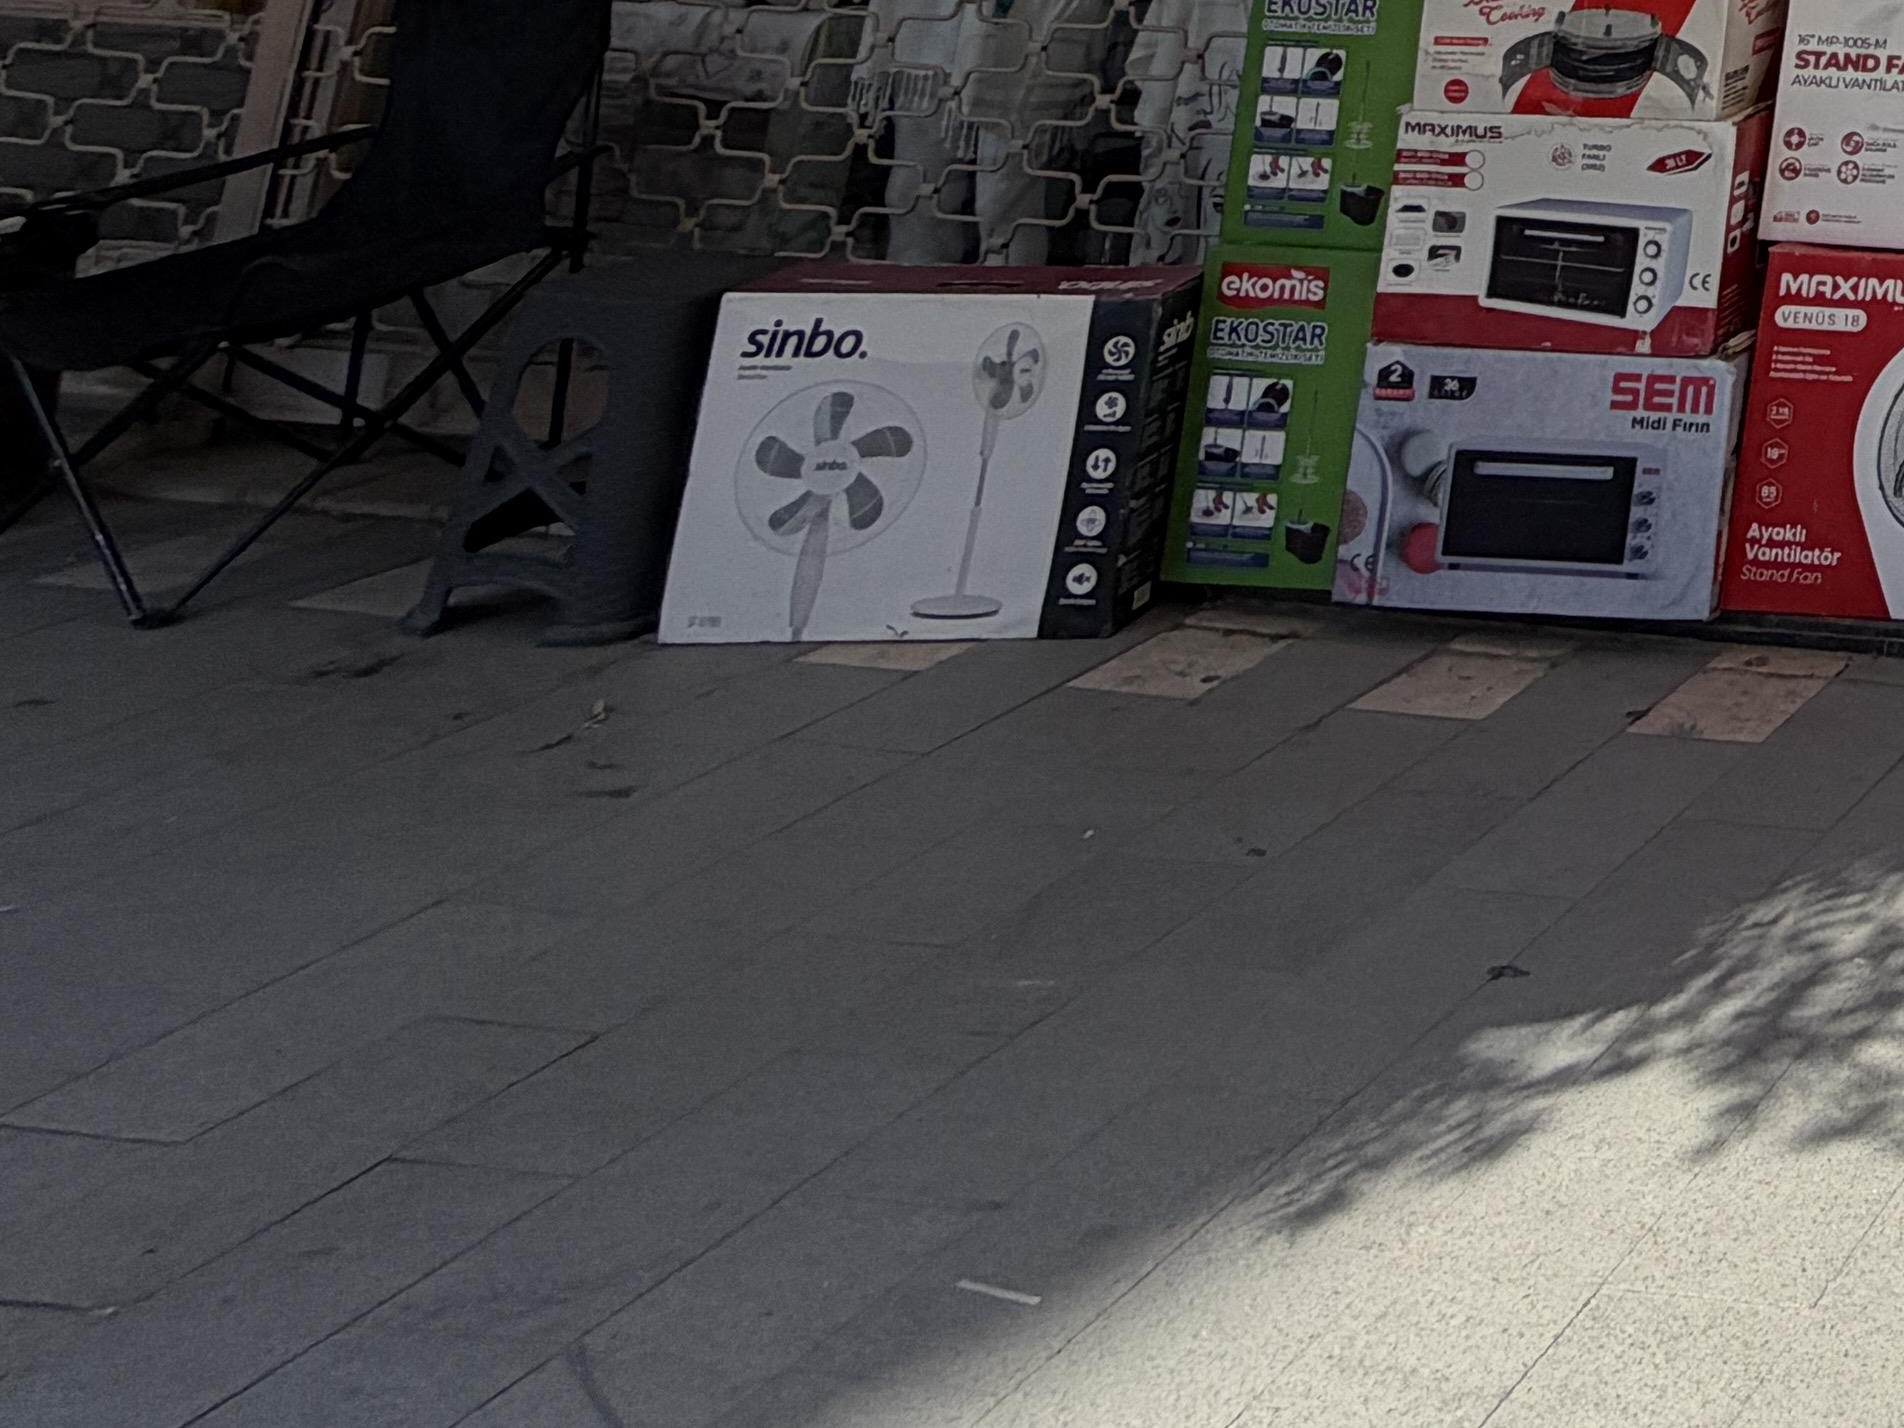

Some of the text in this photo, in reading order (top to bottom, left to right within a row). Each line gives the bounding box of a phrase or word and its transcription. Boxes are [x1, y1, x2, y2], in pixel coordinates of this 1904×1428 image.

[1794, 50, 1881, 75] STAND
[1791, 75, 1840, 90] AYAKLI
[1404, 121, 1503, 140] MAXIMUS
[1221, 269, 1326, 301] ekomis
[1781, 311, 1860, 327] VENÜS 18
[739, 317, 869, 359] sinbo.
[1211, 318, 1326, 347] EKOSTAR
[1387, 365, 1403, 382] 2
[1609, 372, 1717, 415] SEM
[1631, 415, 1711, 434] Midi Fırın
[1746, 522, 1806, 543] Ayaklı
[1745, 542, 1842, 568] Vantilatör
[1740, 564, 1822, 585] Stand Fan
